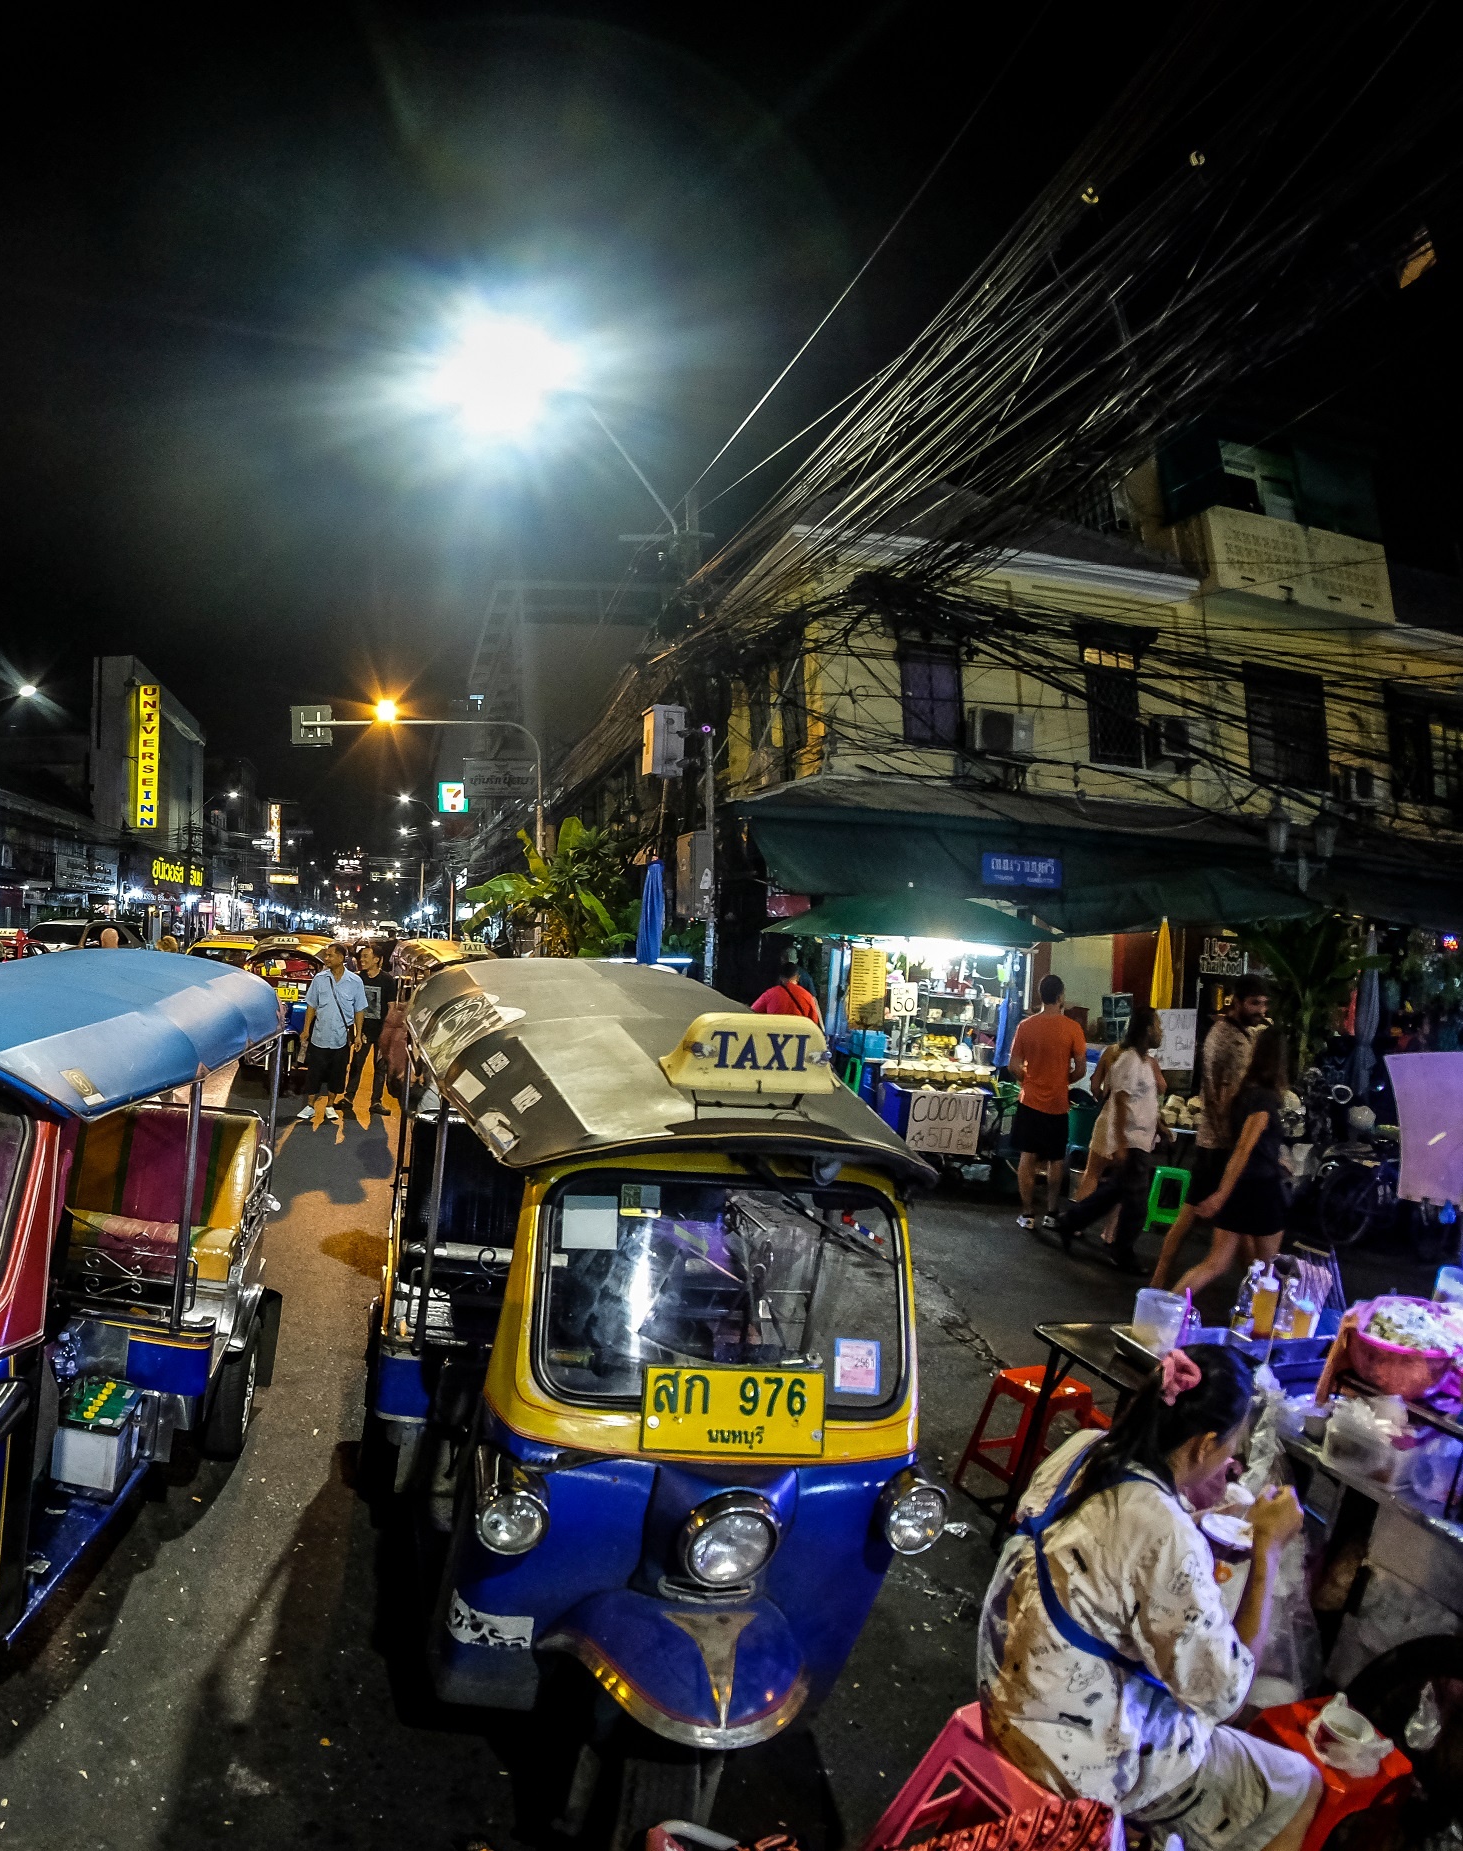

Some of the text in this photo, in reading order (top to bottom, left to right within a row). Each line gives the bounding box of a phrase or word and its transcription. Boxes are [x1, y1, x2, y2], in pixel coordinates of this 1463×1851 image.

[893, 996, 915, 1013] 50
[711, 1029, 811, 1072] TAXI
[912, 1095, 982, 1123] COCONUT
[926, 1127, 953, 1149] 50
[653, 1370, 807, 1418] สก 976
